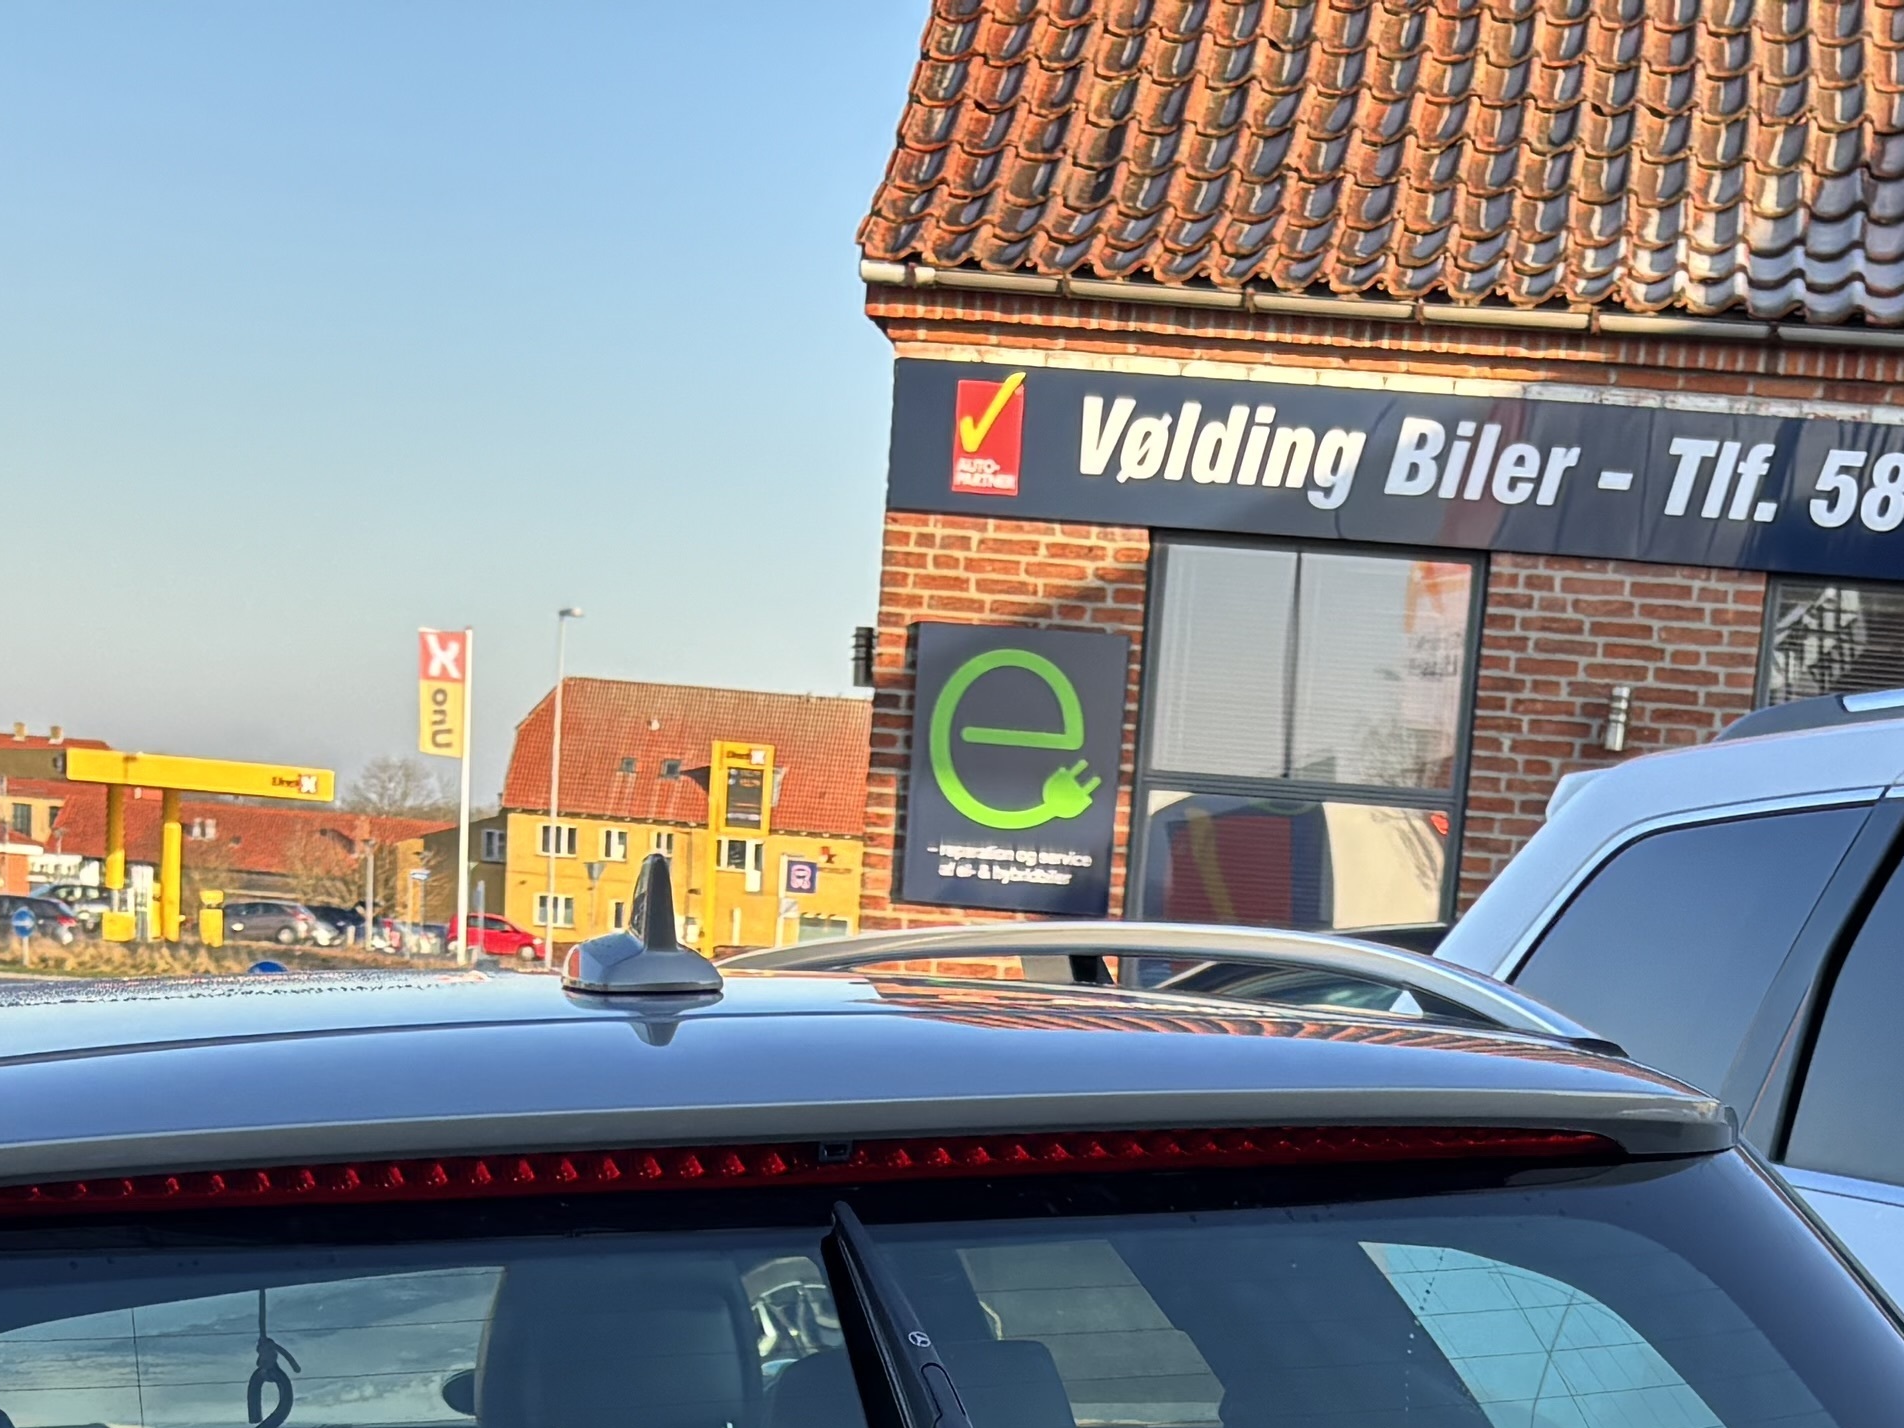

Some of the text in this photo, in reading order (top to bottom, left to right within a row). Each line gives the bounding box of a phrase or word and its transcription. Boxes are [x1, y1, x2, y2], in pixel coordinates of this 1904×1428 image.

[1079, 394, 1367, 510] Vølding
[1383, 415, 1581, 506] Biler
[1664, 436, 1778, 523] Tlf.
